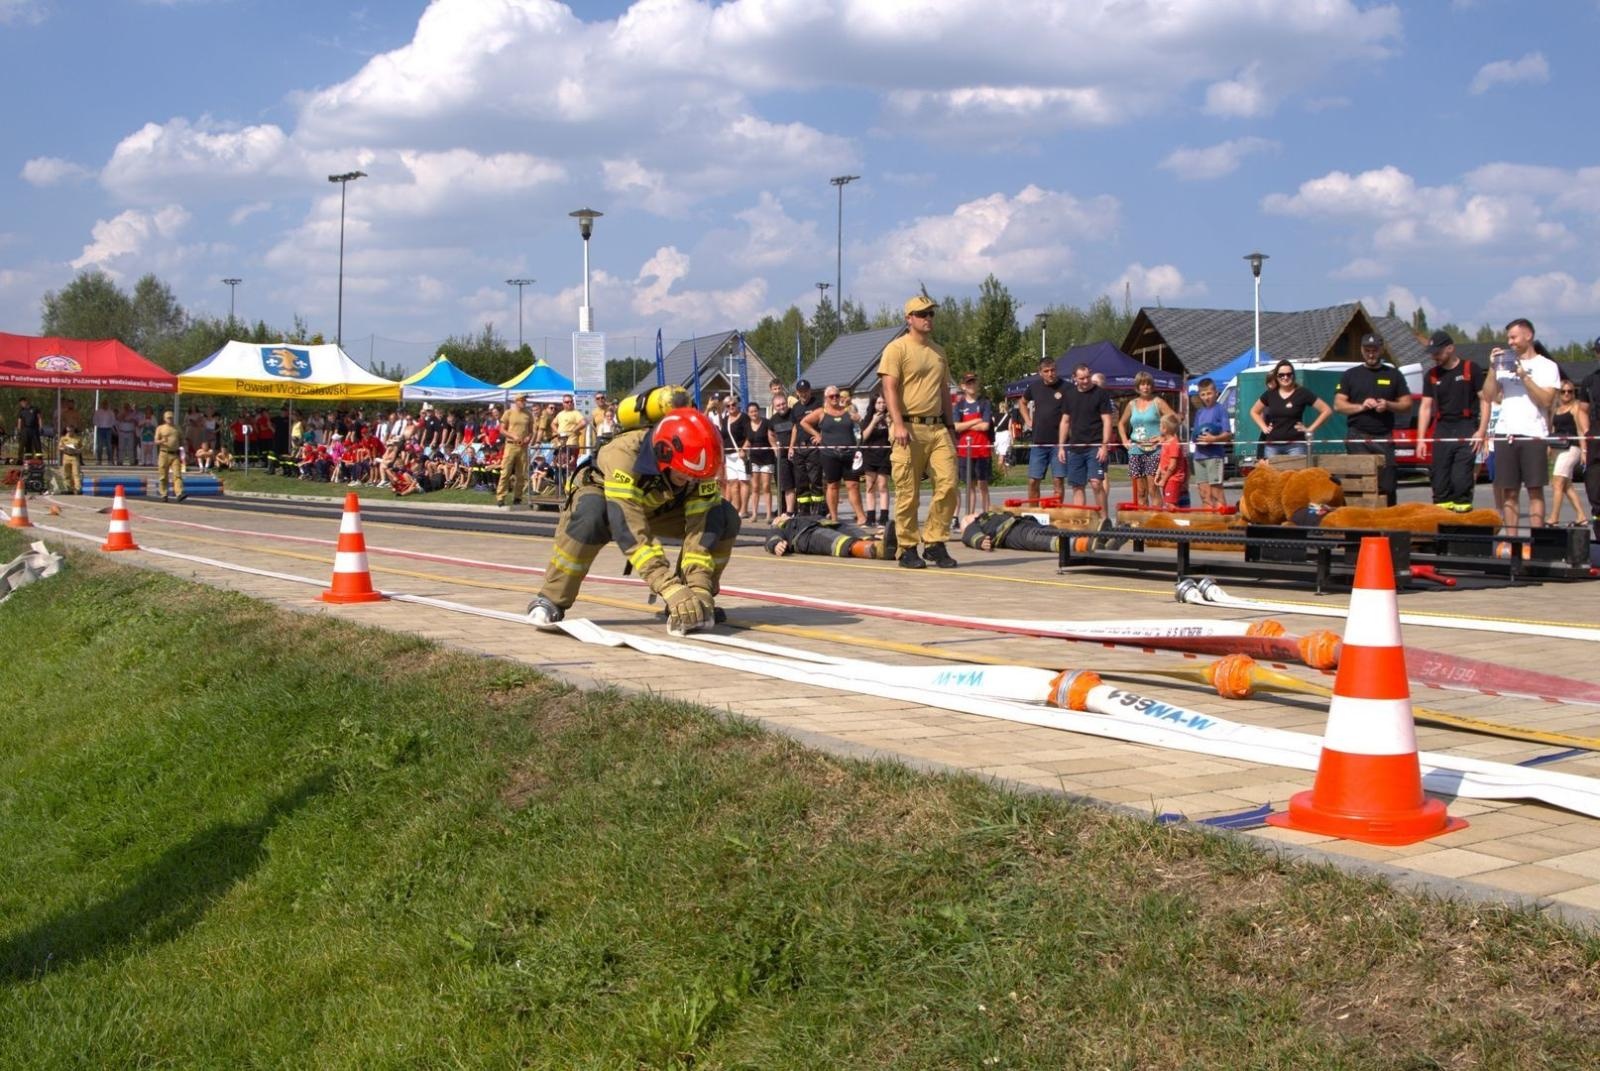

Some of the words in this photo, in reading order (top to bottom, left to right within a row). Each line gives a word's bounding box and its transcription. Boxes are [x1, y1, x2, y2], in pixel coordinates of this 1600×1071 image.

[236, 381, 273, 393] Powiat
[276, 383, 349, 396] Wodzisławski
[614, 472, 631, 484] PSP
